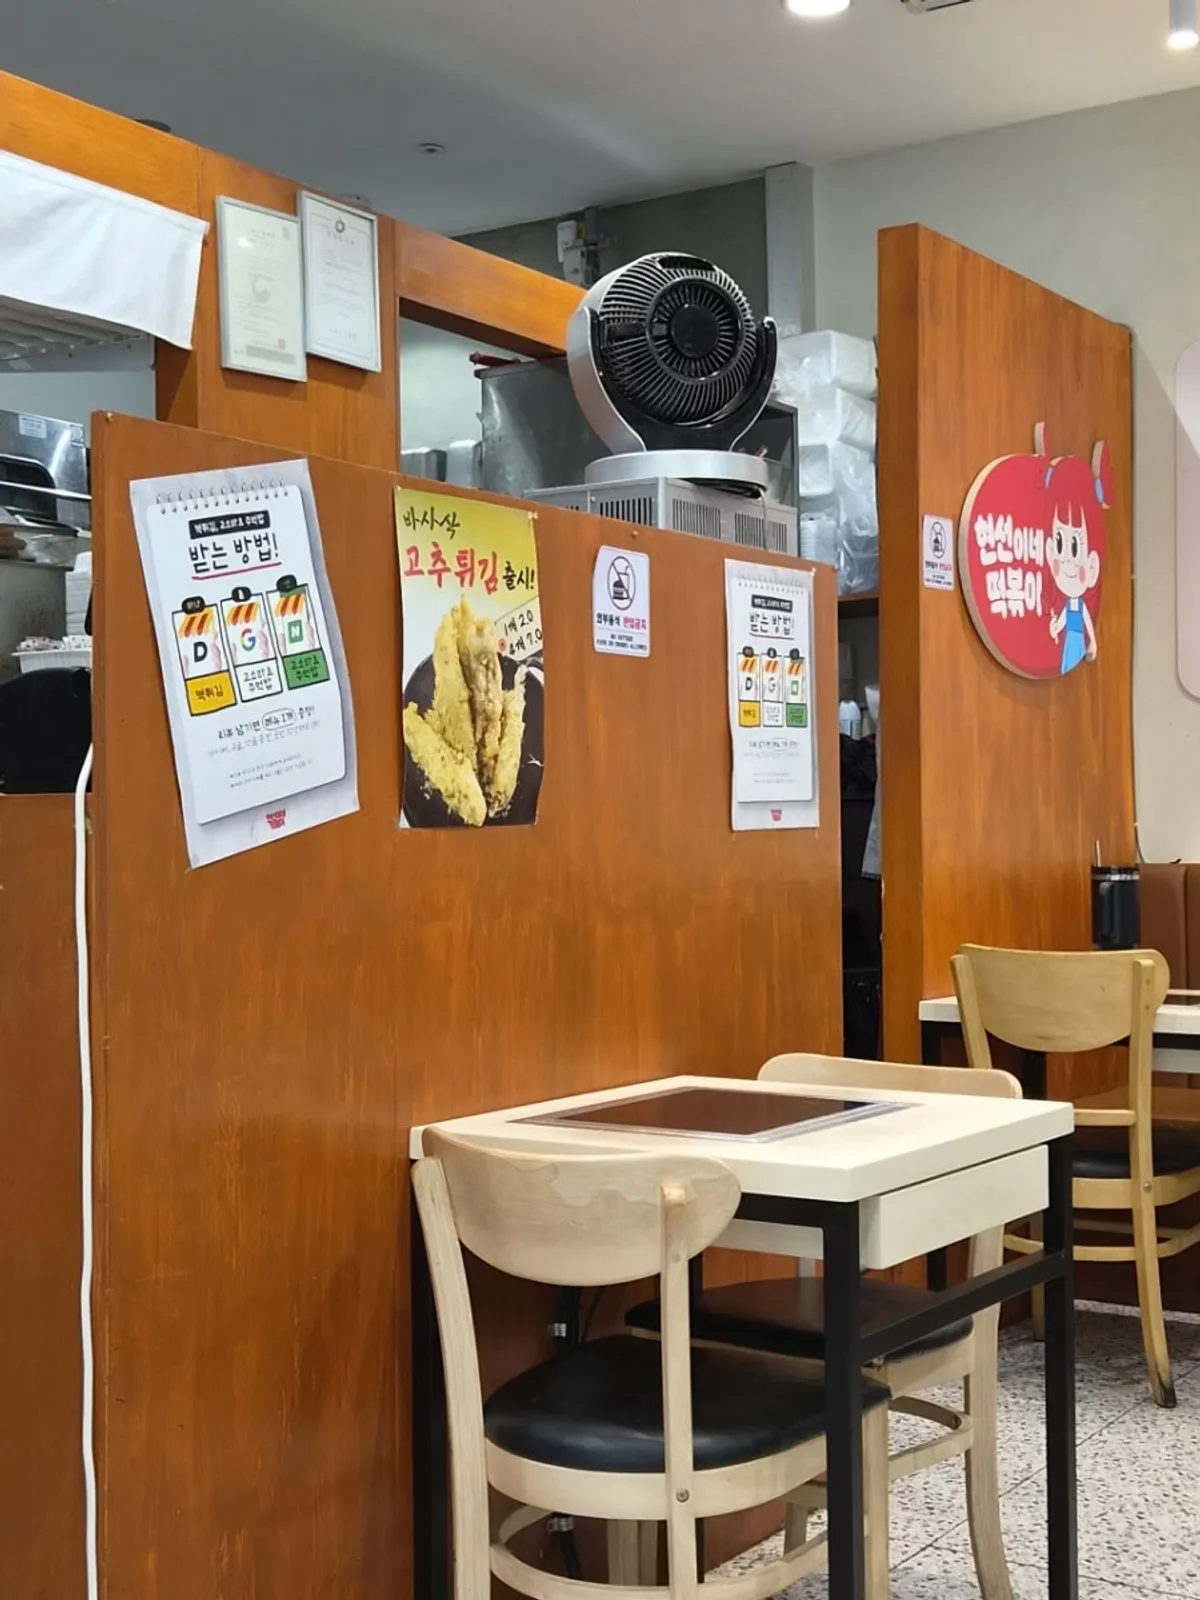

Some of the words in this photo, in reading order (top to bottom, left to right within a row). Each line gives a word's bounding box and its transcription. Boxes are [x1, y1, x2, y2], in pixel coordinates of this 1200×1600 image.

[403, 506, 460, 540] 바사삭
[974, 513, 1044, 567] 현선이네
[189, 541, 229, 573] 받는
[233, 532, 279, 563] 방법!
[404, 541, 499, 596] 고추튀김
[502, 560, 535, 591] 출시!
[985, 566, 1042, 619] 떡볶이
[518, 609, 534, 629] 2.0
[750, 612, 769, 633] 받는
[240, 628, 256, 651] G
[526, 628, 543, 644] 7.0
[193, 641, 208, 662] D
[745, 677, 753, 691] D
[235, 720, 260, 736] 남기면
